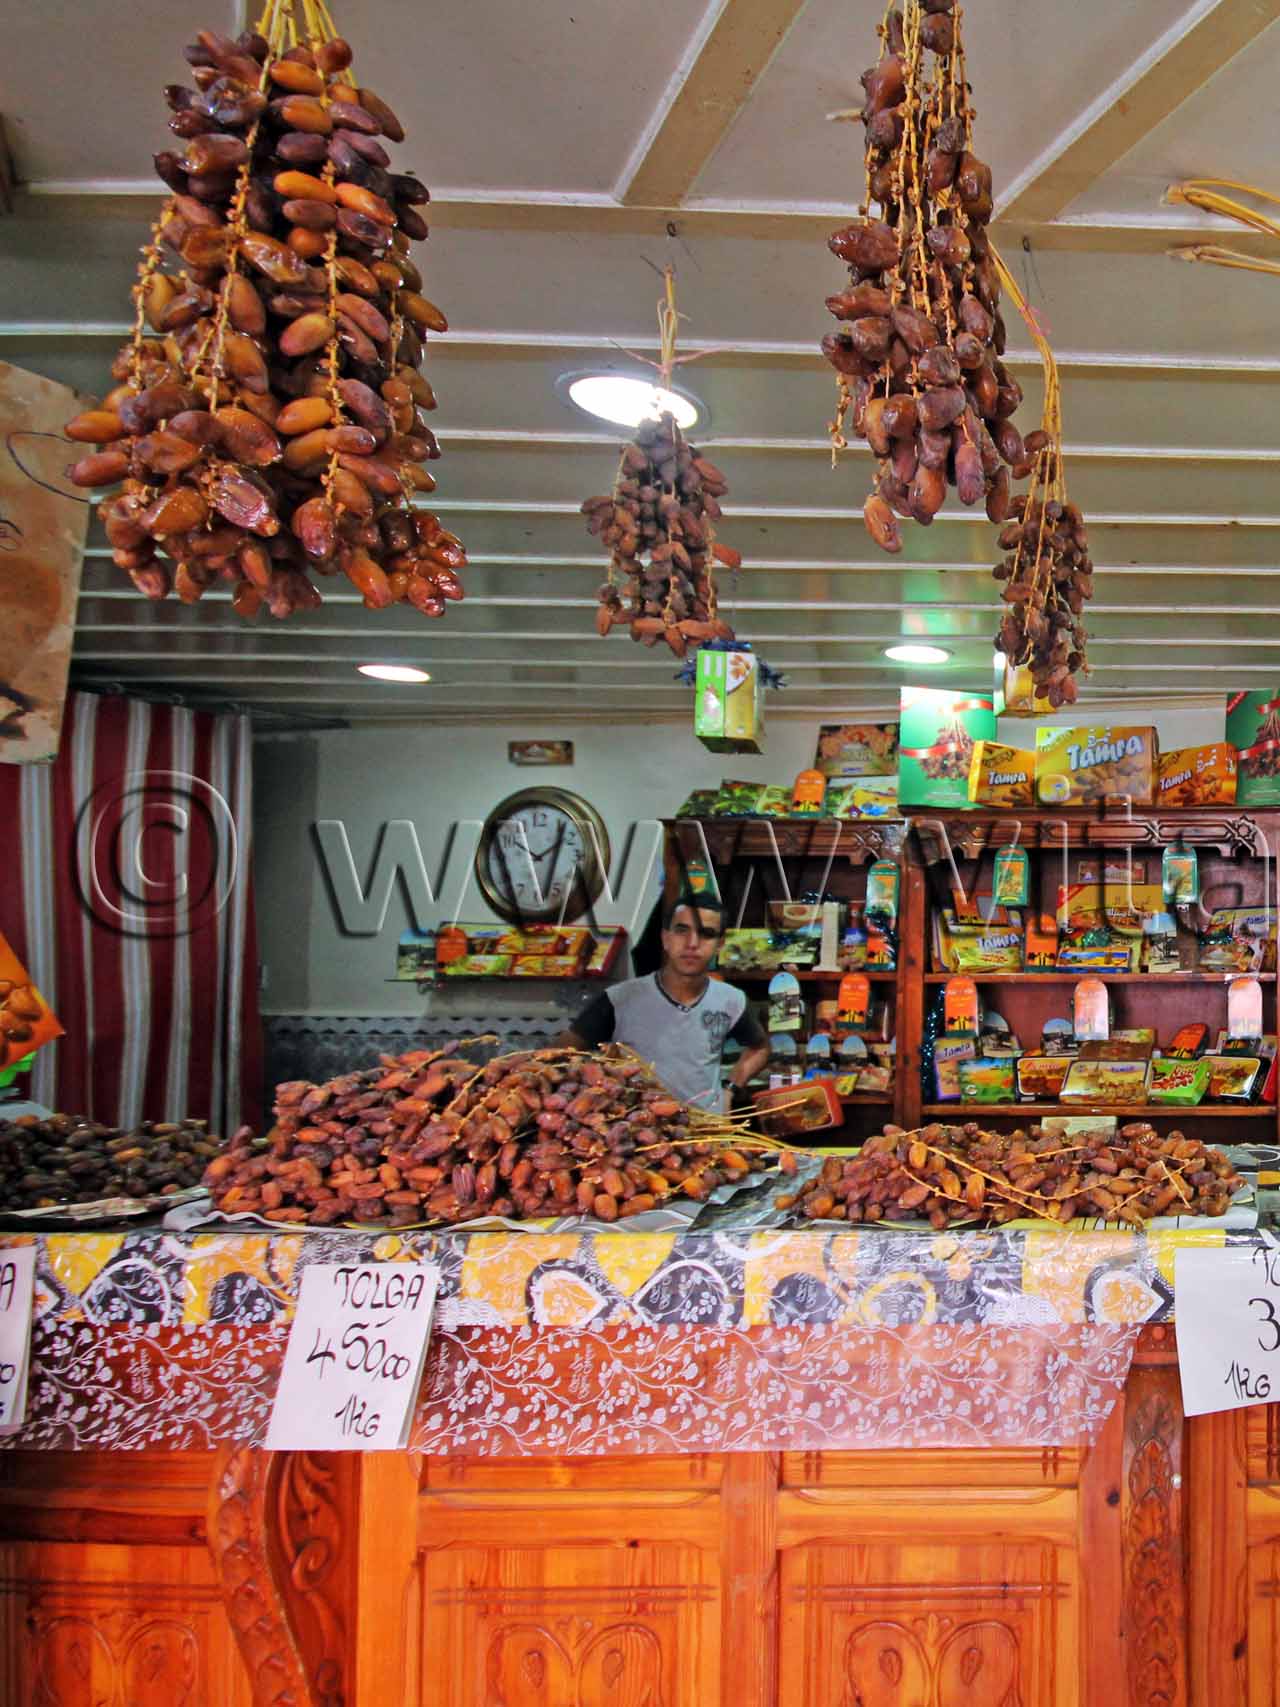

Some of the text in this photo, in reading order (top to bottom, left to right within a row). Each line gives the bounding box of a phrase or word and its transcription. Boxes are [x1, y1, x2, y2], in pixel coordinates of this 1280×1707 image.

[1066, 735, 1144, 772] Tamra
[988, 771, 1027, 786] Tamra
[1159, 769, 1192, 791] Tamra
[334, 1267, 425, 1311] TOLGA
